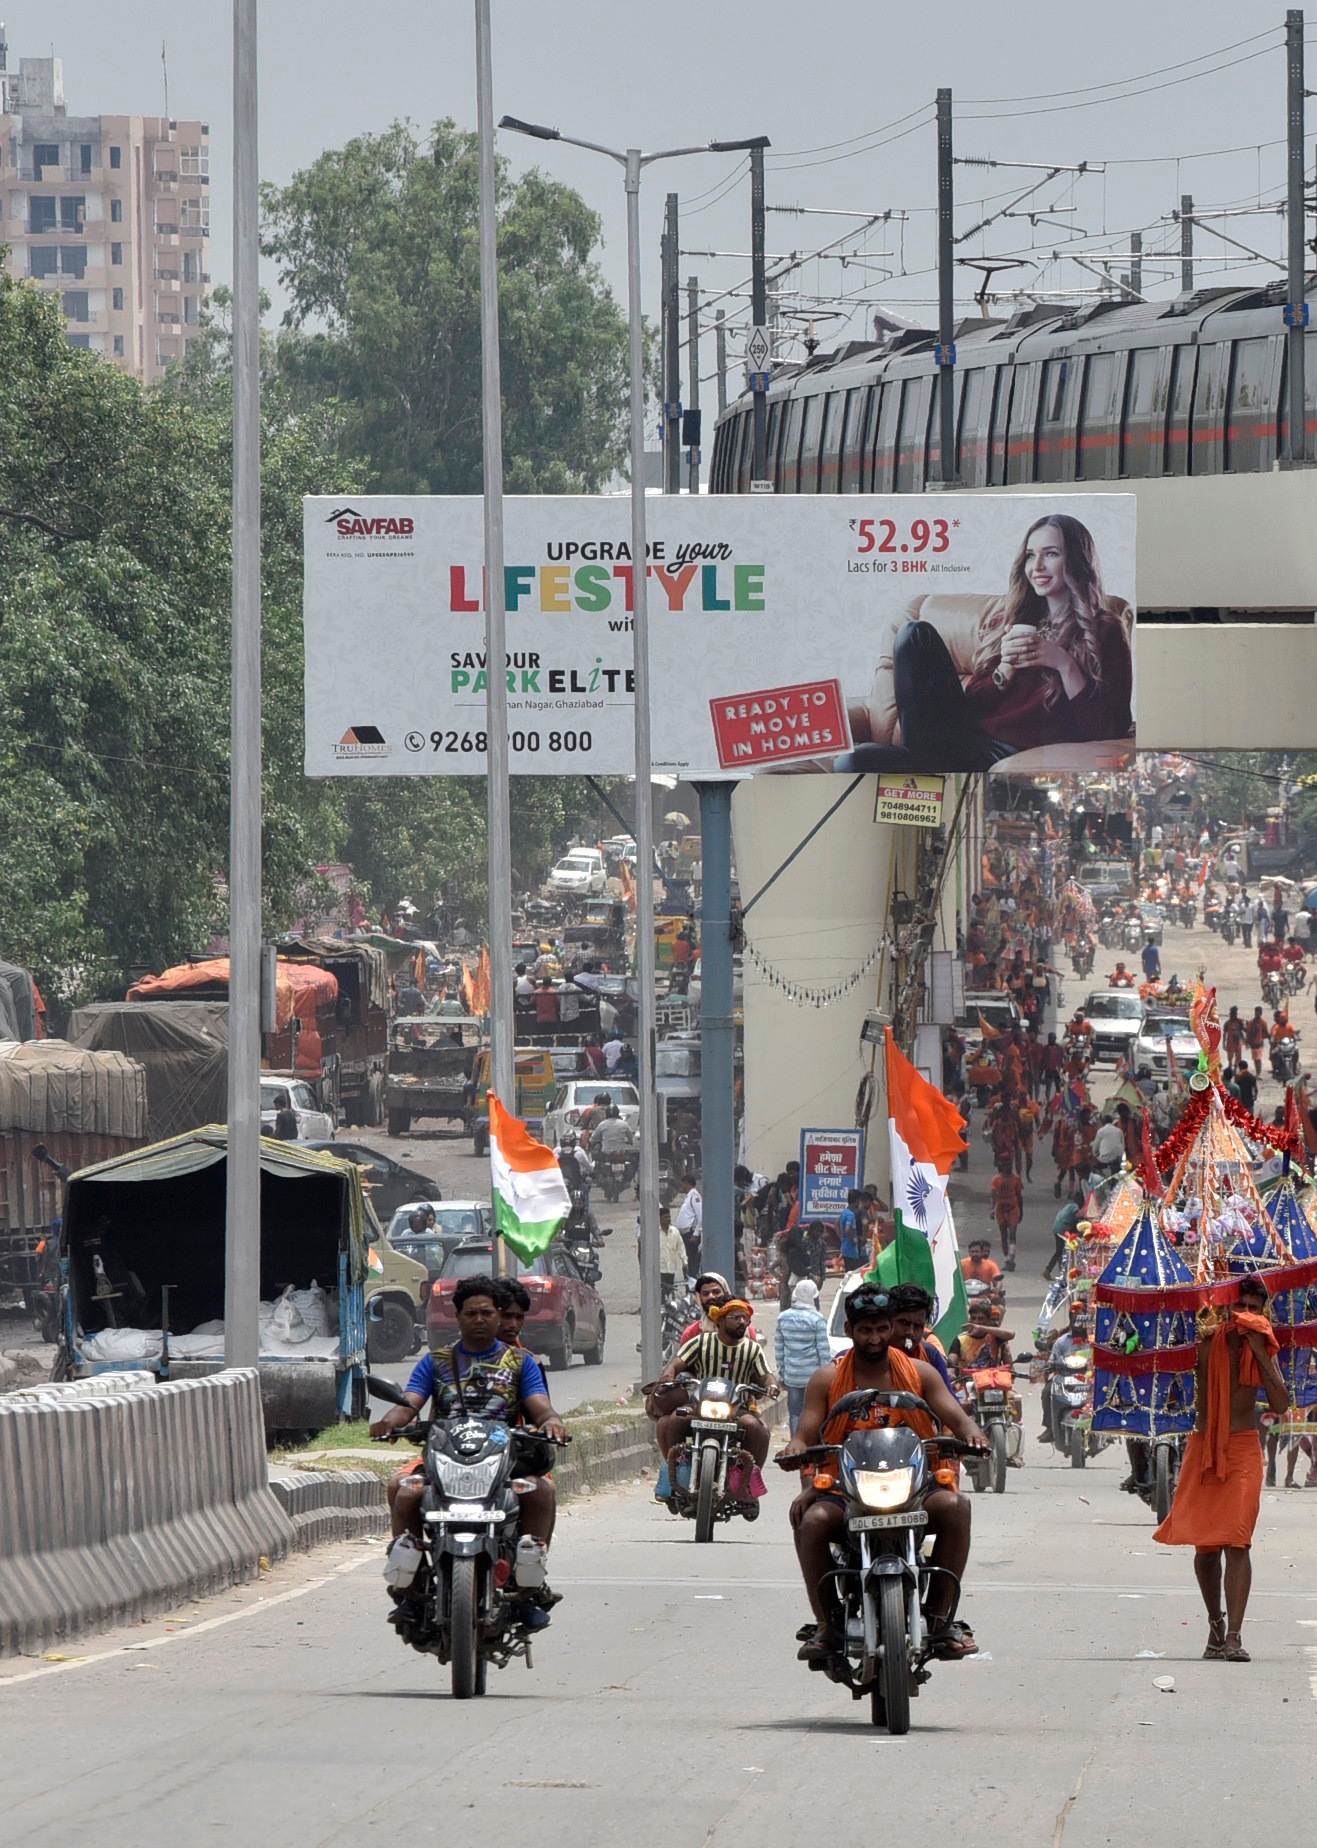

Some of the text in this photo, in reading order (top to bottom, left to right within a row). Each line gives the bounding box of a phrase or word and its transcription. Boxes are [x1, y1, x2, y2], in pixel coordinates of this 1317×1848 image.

[752, 344, 766, 355] 250
[336, 518, 414, 535] SAVFAB
[667, 541, 733, 574] your
[847, 560, 870, 574] Lacs
[872, 560, 888, 573] for
[890, 560, 898, 573] 3
[902, 560, 928, 573] BHK
[449, 565, 766, 612] LFESTYLE
[555, 699, 604, 709] Ghaziabad
[724, 690, 828, 722] READY TO
[749, 712, 811, 736] MOVE
[430, 731, 592, 752] 9268 00 800
[731, 727, 833, 758] IN HOMES
[884, 788, 937, 801] GET MORE
[881, 801, 937, 813] 7048944711
[880, 811, 937, 823] 9810806962
[819, 1151, 843, 1162] हमेशा
[814, 1163, 830, 1174] सीट
[887, 1516, 897, 1525] AT
